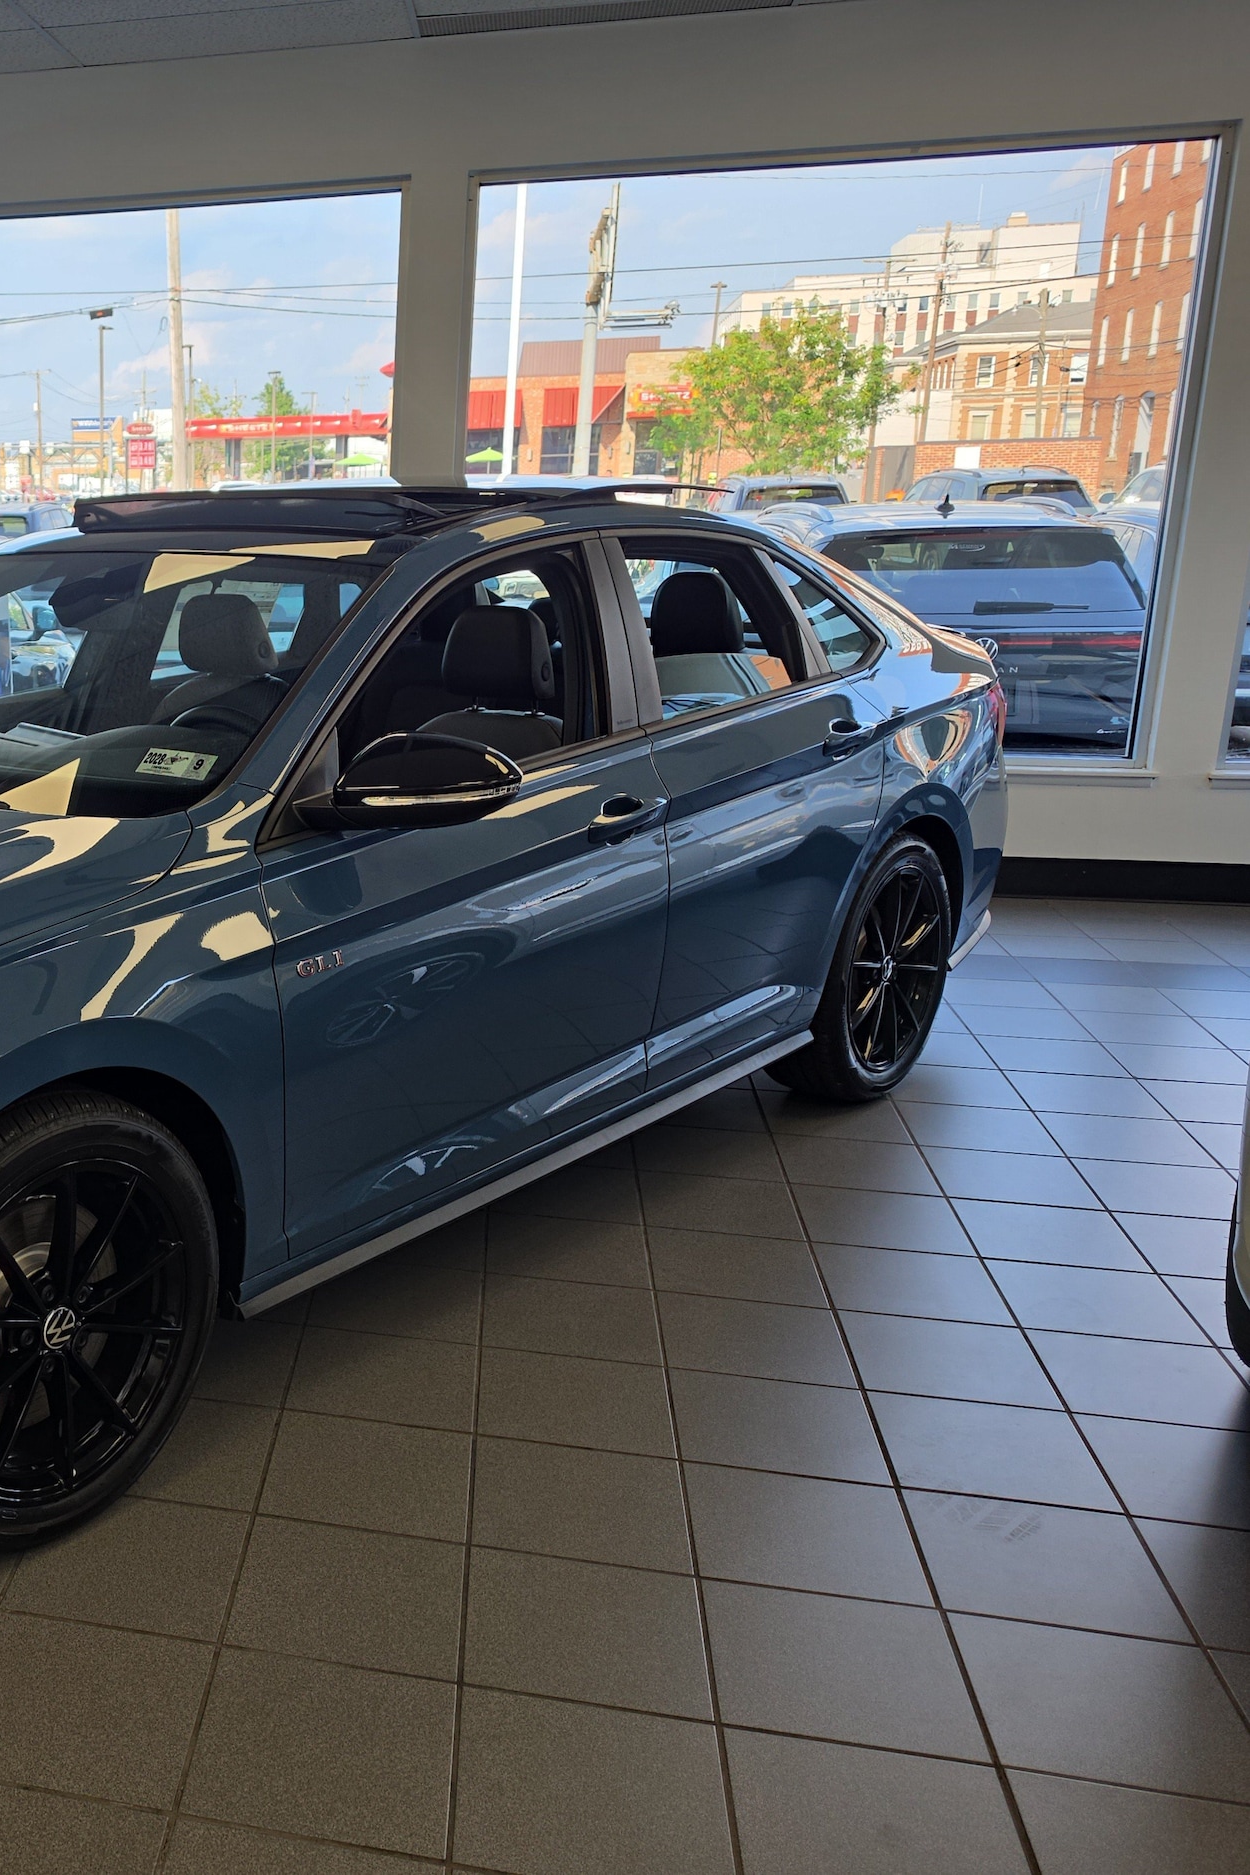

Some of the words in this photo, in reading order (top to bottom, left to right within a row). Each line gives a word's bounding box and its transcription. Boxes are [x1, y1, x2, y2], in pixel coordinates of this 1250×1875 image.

[143, 751, 167, 765] 2028
[193, 758, 205, 771] 9
[296, 949, 345, 978] GLI
